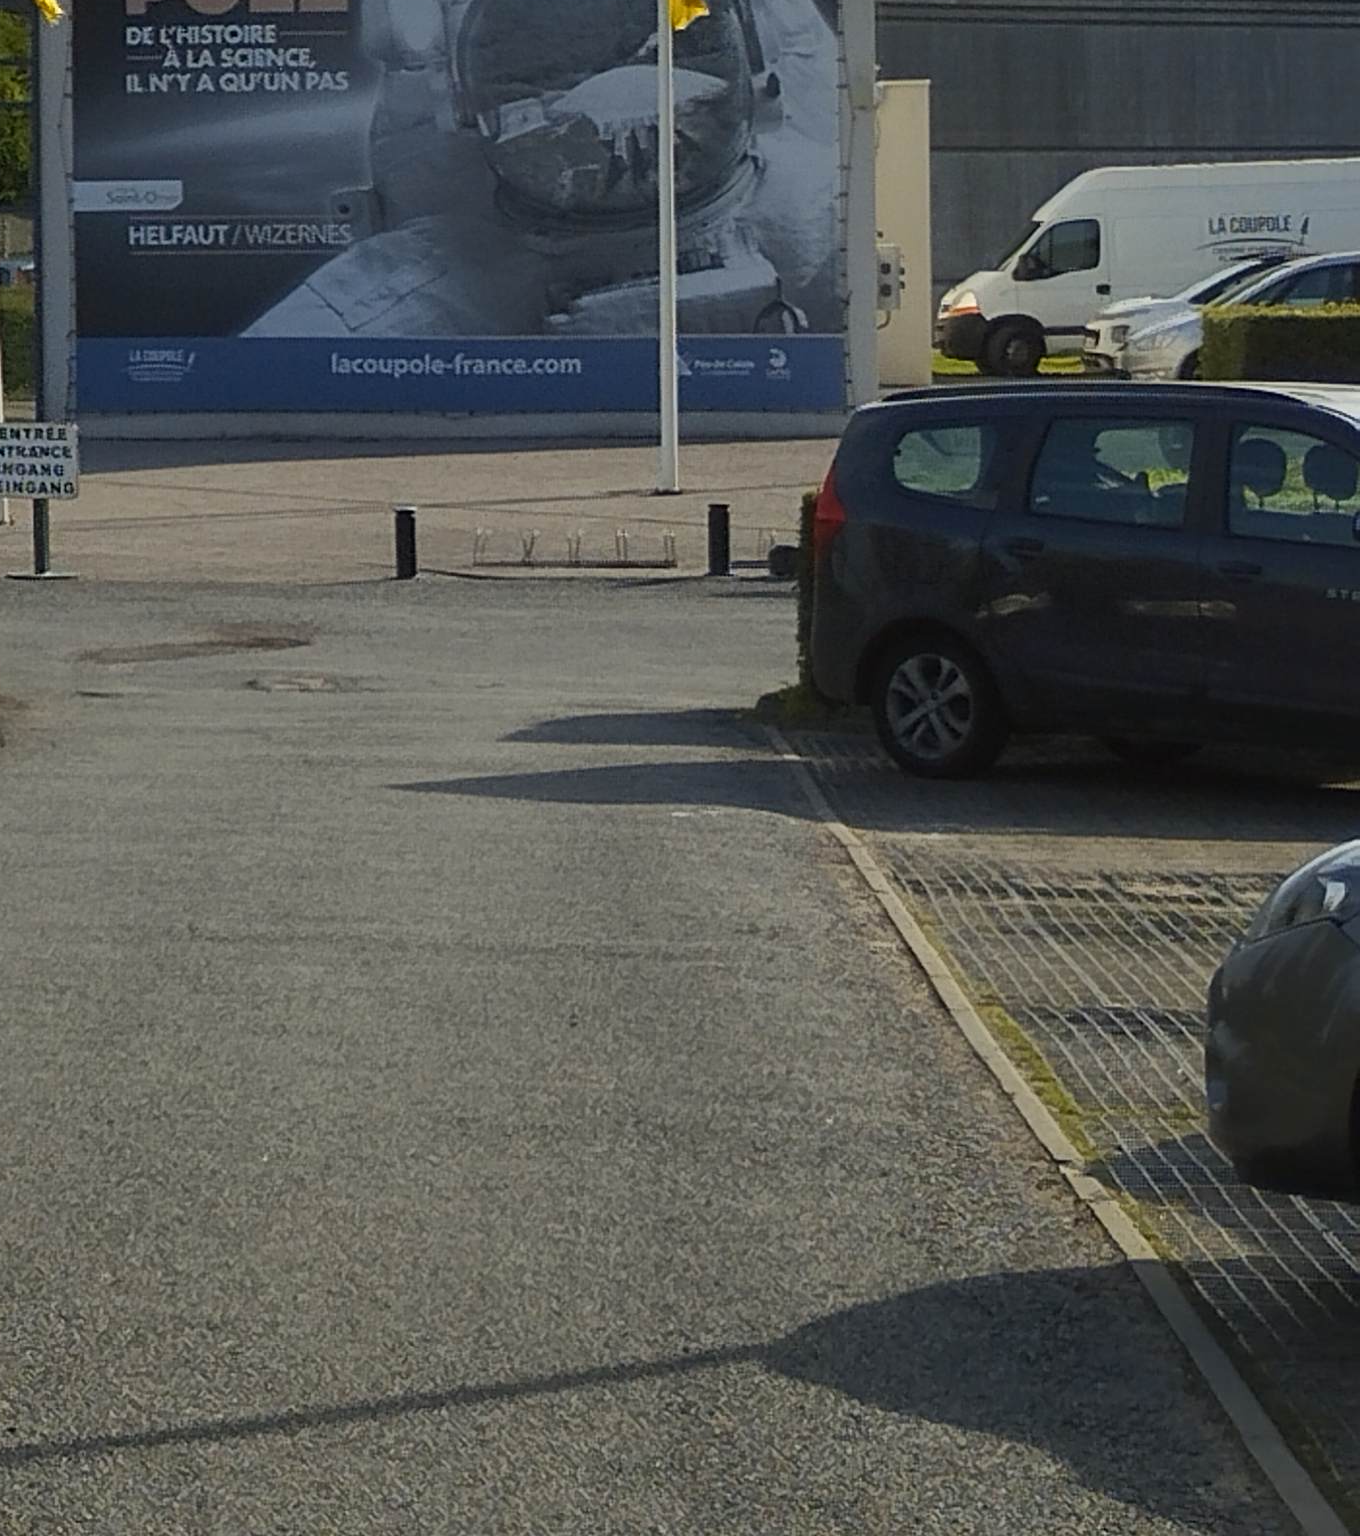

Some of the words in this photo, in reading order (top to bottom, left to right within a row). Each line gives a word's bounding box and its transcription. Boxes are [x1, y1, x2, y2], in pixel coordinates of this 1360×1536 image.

[126, 26, 154, 45] DE
[160, 24, 277, 44] L'HISTOIRE
[186, 50, 215, 68] LA
[221, 48, 316, 68] SCIENCE,
[126, 75, 143, 92] IL
[150, 73, 191, 92] N'Y
[196, 74, 215, 92] A
[219, 72, 300, 92] QU'UN
[305, 71, 349, 90] PAS
[129, 224, 228, 246] HELFAUT
[244, 223, 352, 245] WIZERNES
[1208, 216, 1226, 235] LA
[1229, 214, 1292, 234] COUPOLE
[331, 353, 581, 378] lacoupole-france.com
